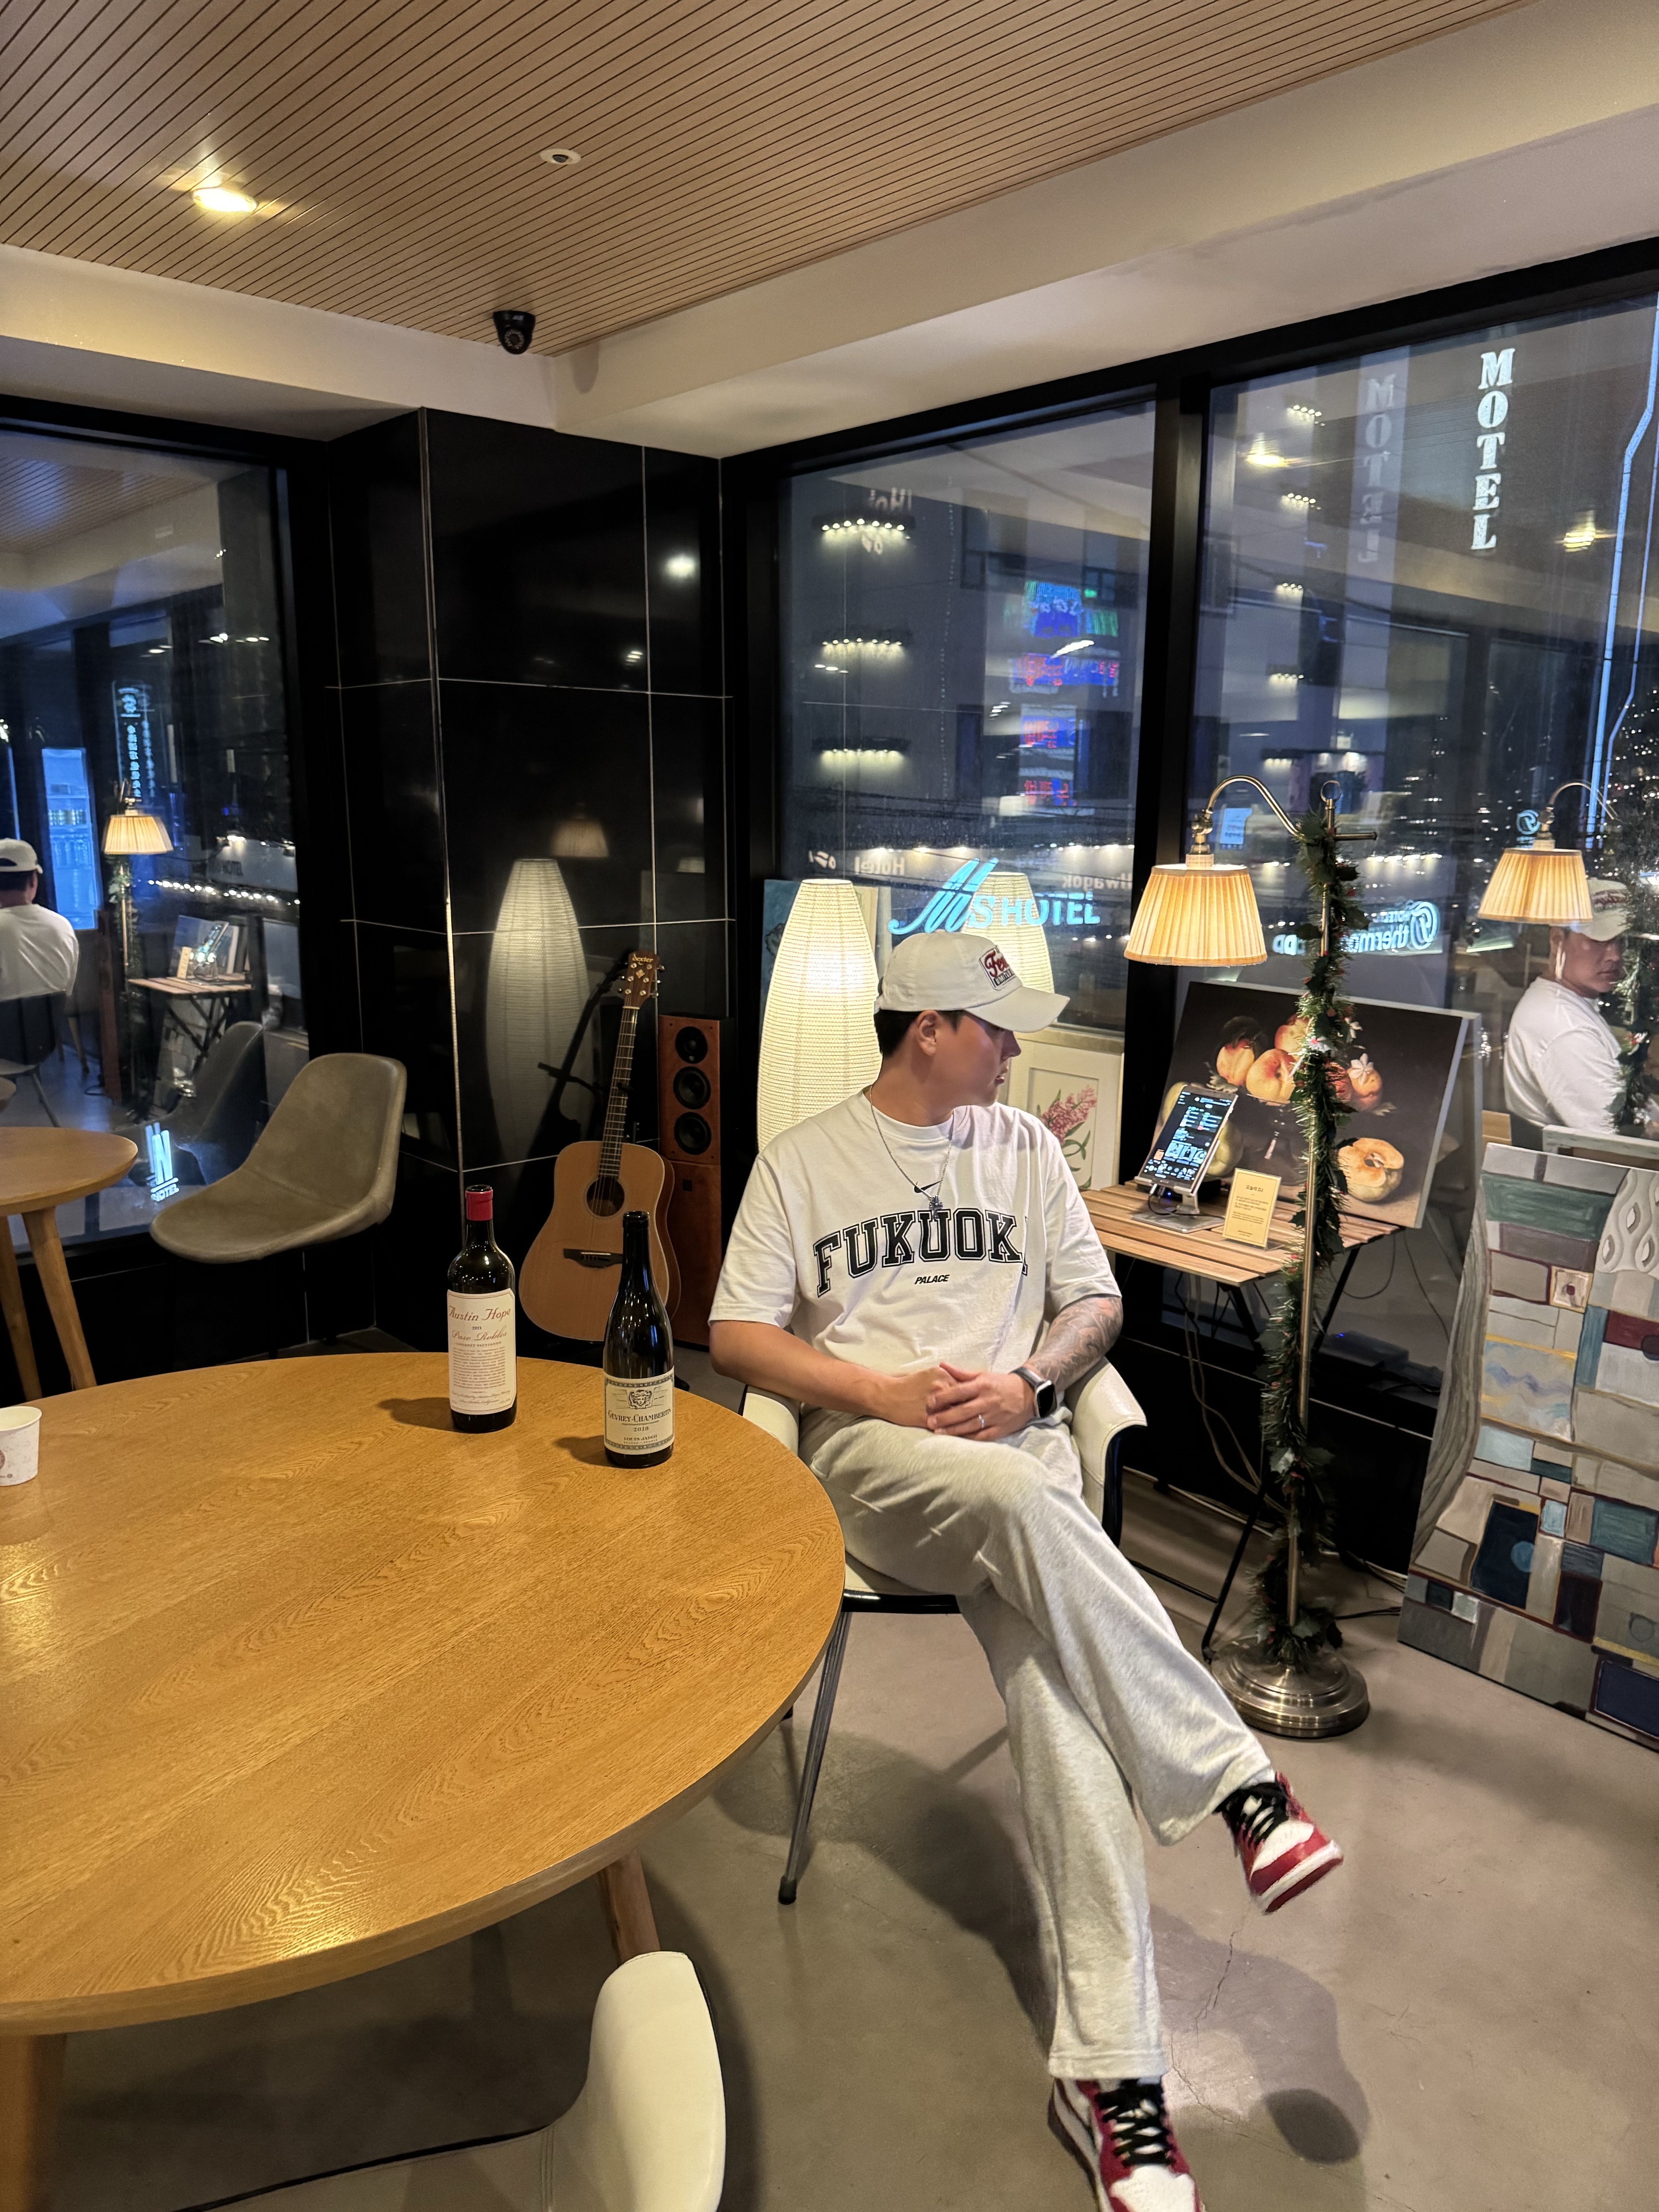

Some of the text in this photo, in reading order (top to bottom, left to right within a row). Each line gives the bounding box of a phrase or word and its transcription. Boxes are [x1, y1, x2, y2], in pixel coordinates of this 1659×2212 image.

[1471, 348, 1516, 550] MOTEL
[1001, 891, 1101, 926] HOTEL
[813, 1208, 1028, 1298] FUKUOK
[914, 1274, 950, 1285] PALACE
[448, 1305, 511, 1322] Austin Hope
[474, 1325, 507, 1341] Robles
[608, 1408, 672, 1422] GEVREY-CHAMBERTIN
